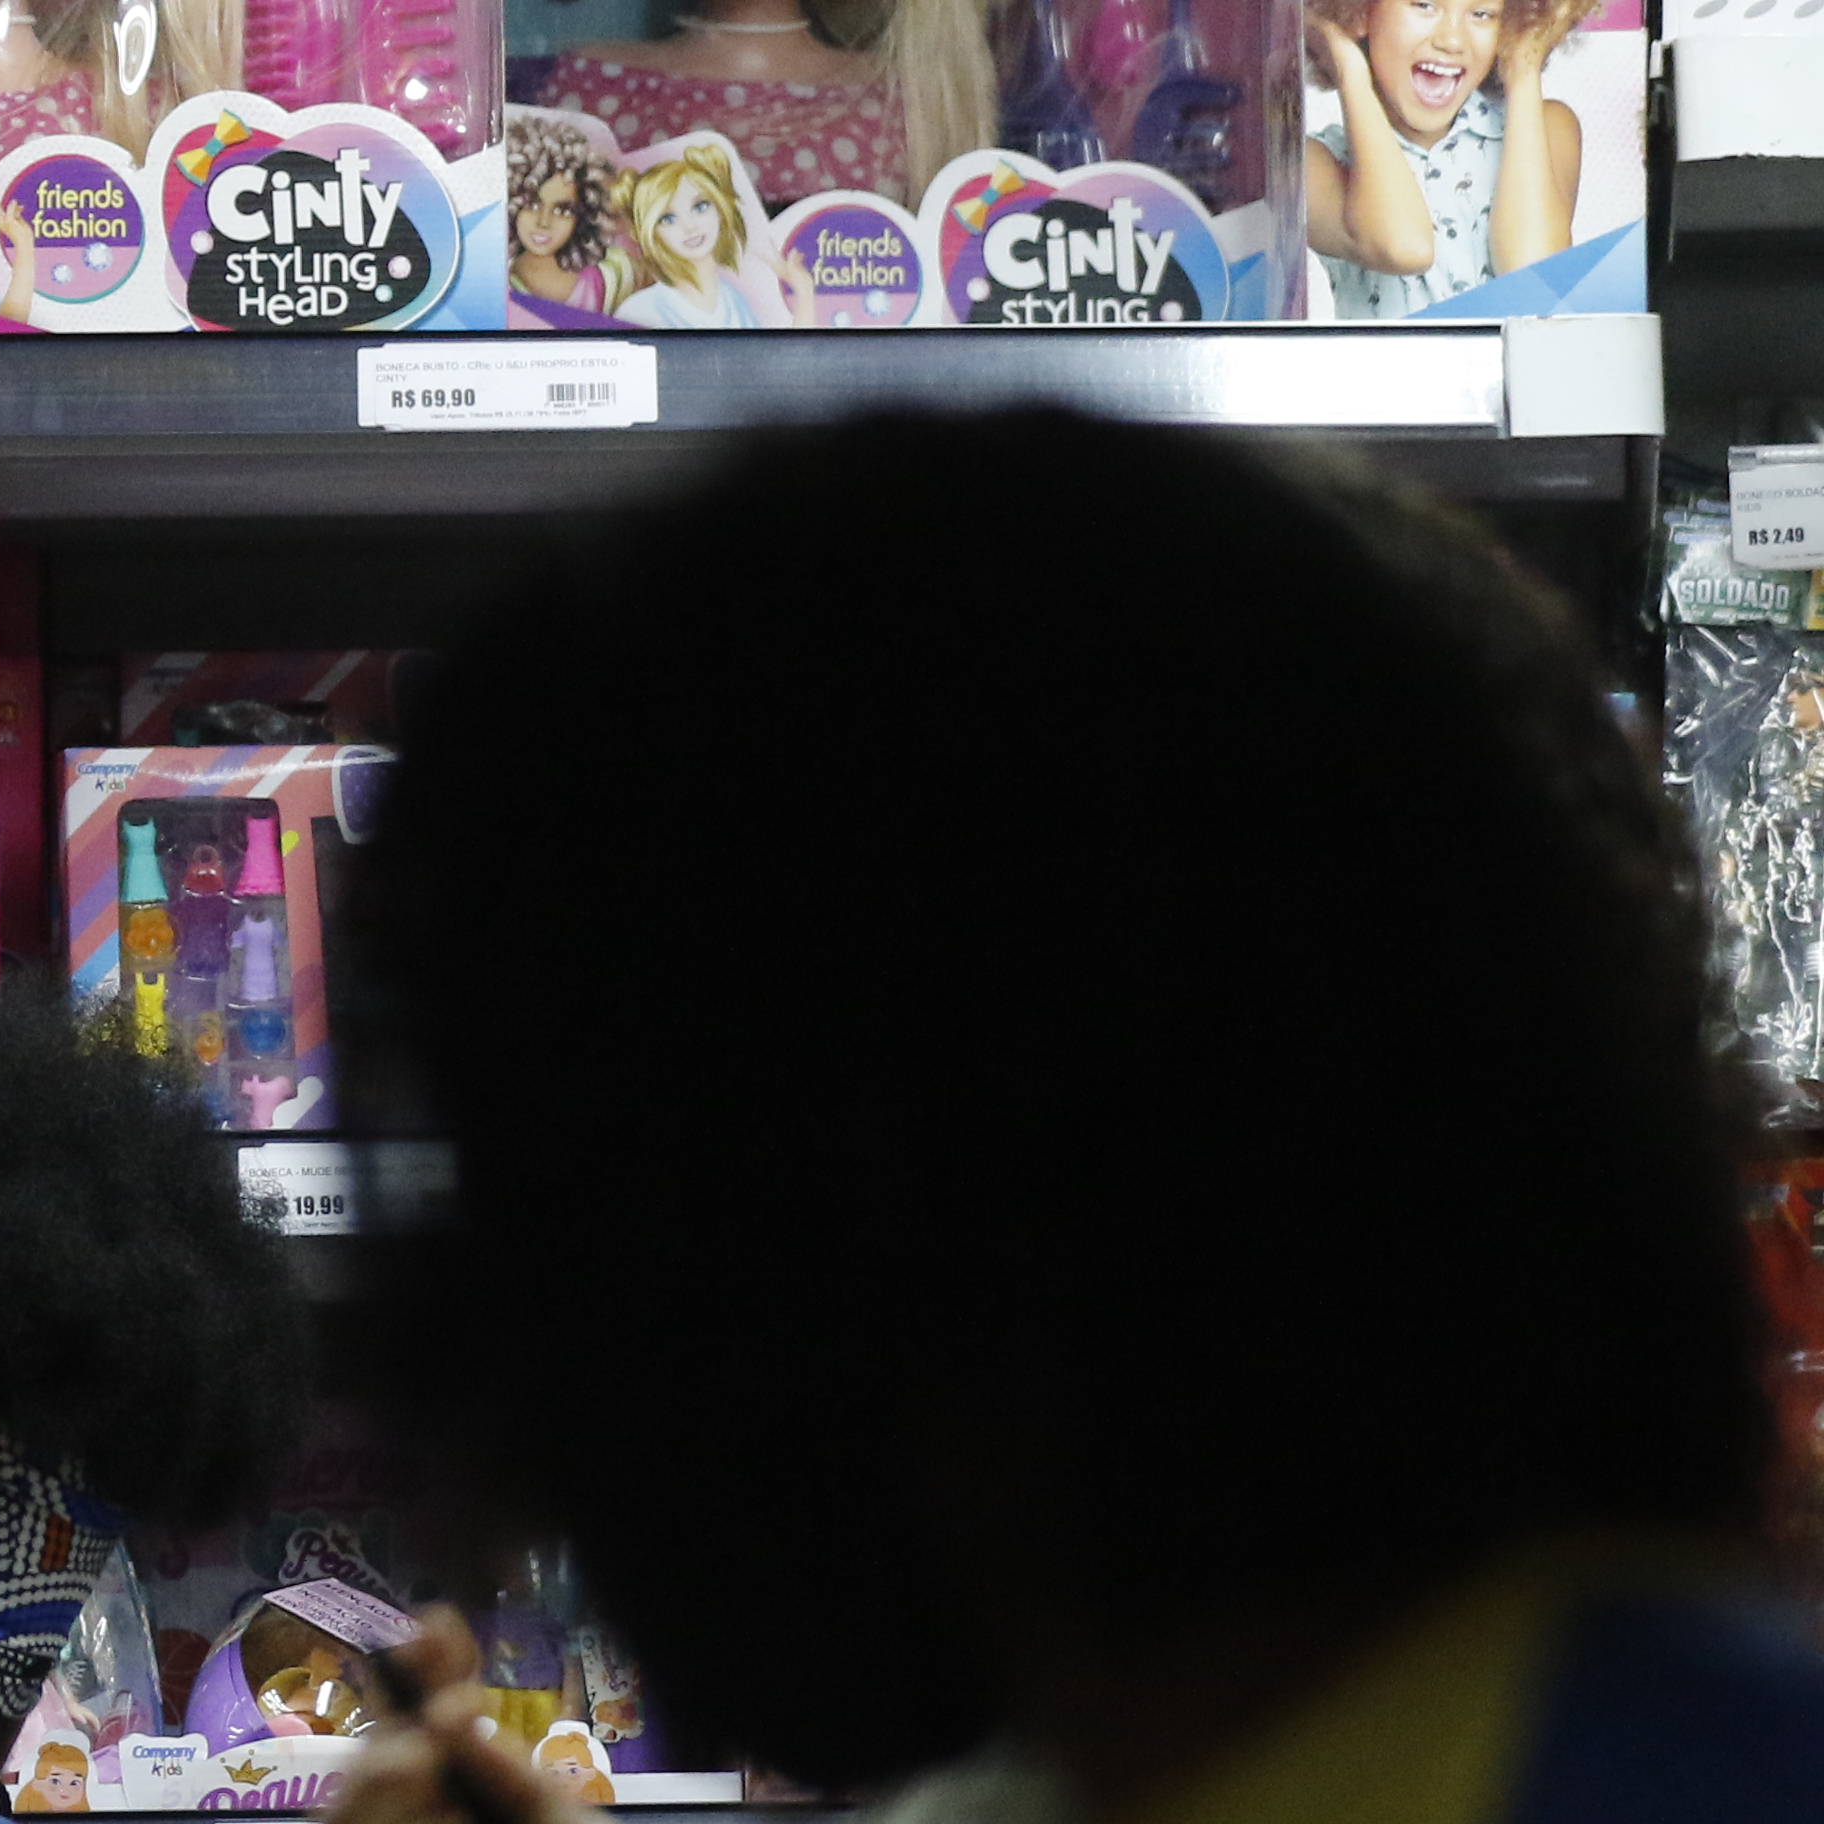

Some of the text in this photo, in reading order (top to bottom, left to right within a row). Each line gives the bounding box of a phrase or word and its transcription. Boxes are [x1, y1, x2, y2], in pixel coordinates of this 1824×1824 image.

[37, 181, 125, 211] friends
[33, 211, 127, 242] fashion
[816, 230, 901, 259] friends
[813, 257, 904, 288] fashion
[392, 388, 475, 409] R$ 69,90
[1749, 528, 1804, 545] R$ 2,49
[1680, 579, 1789, 610] SOLDADO
[78, 762, 137, 777] Company
[296, 1197, 344, 1216] 19,99
[132, 1745, 196, 1761] Company
